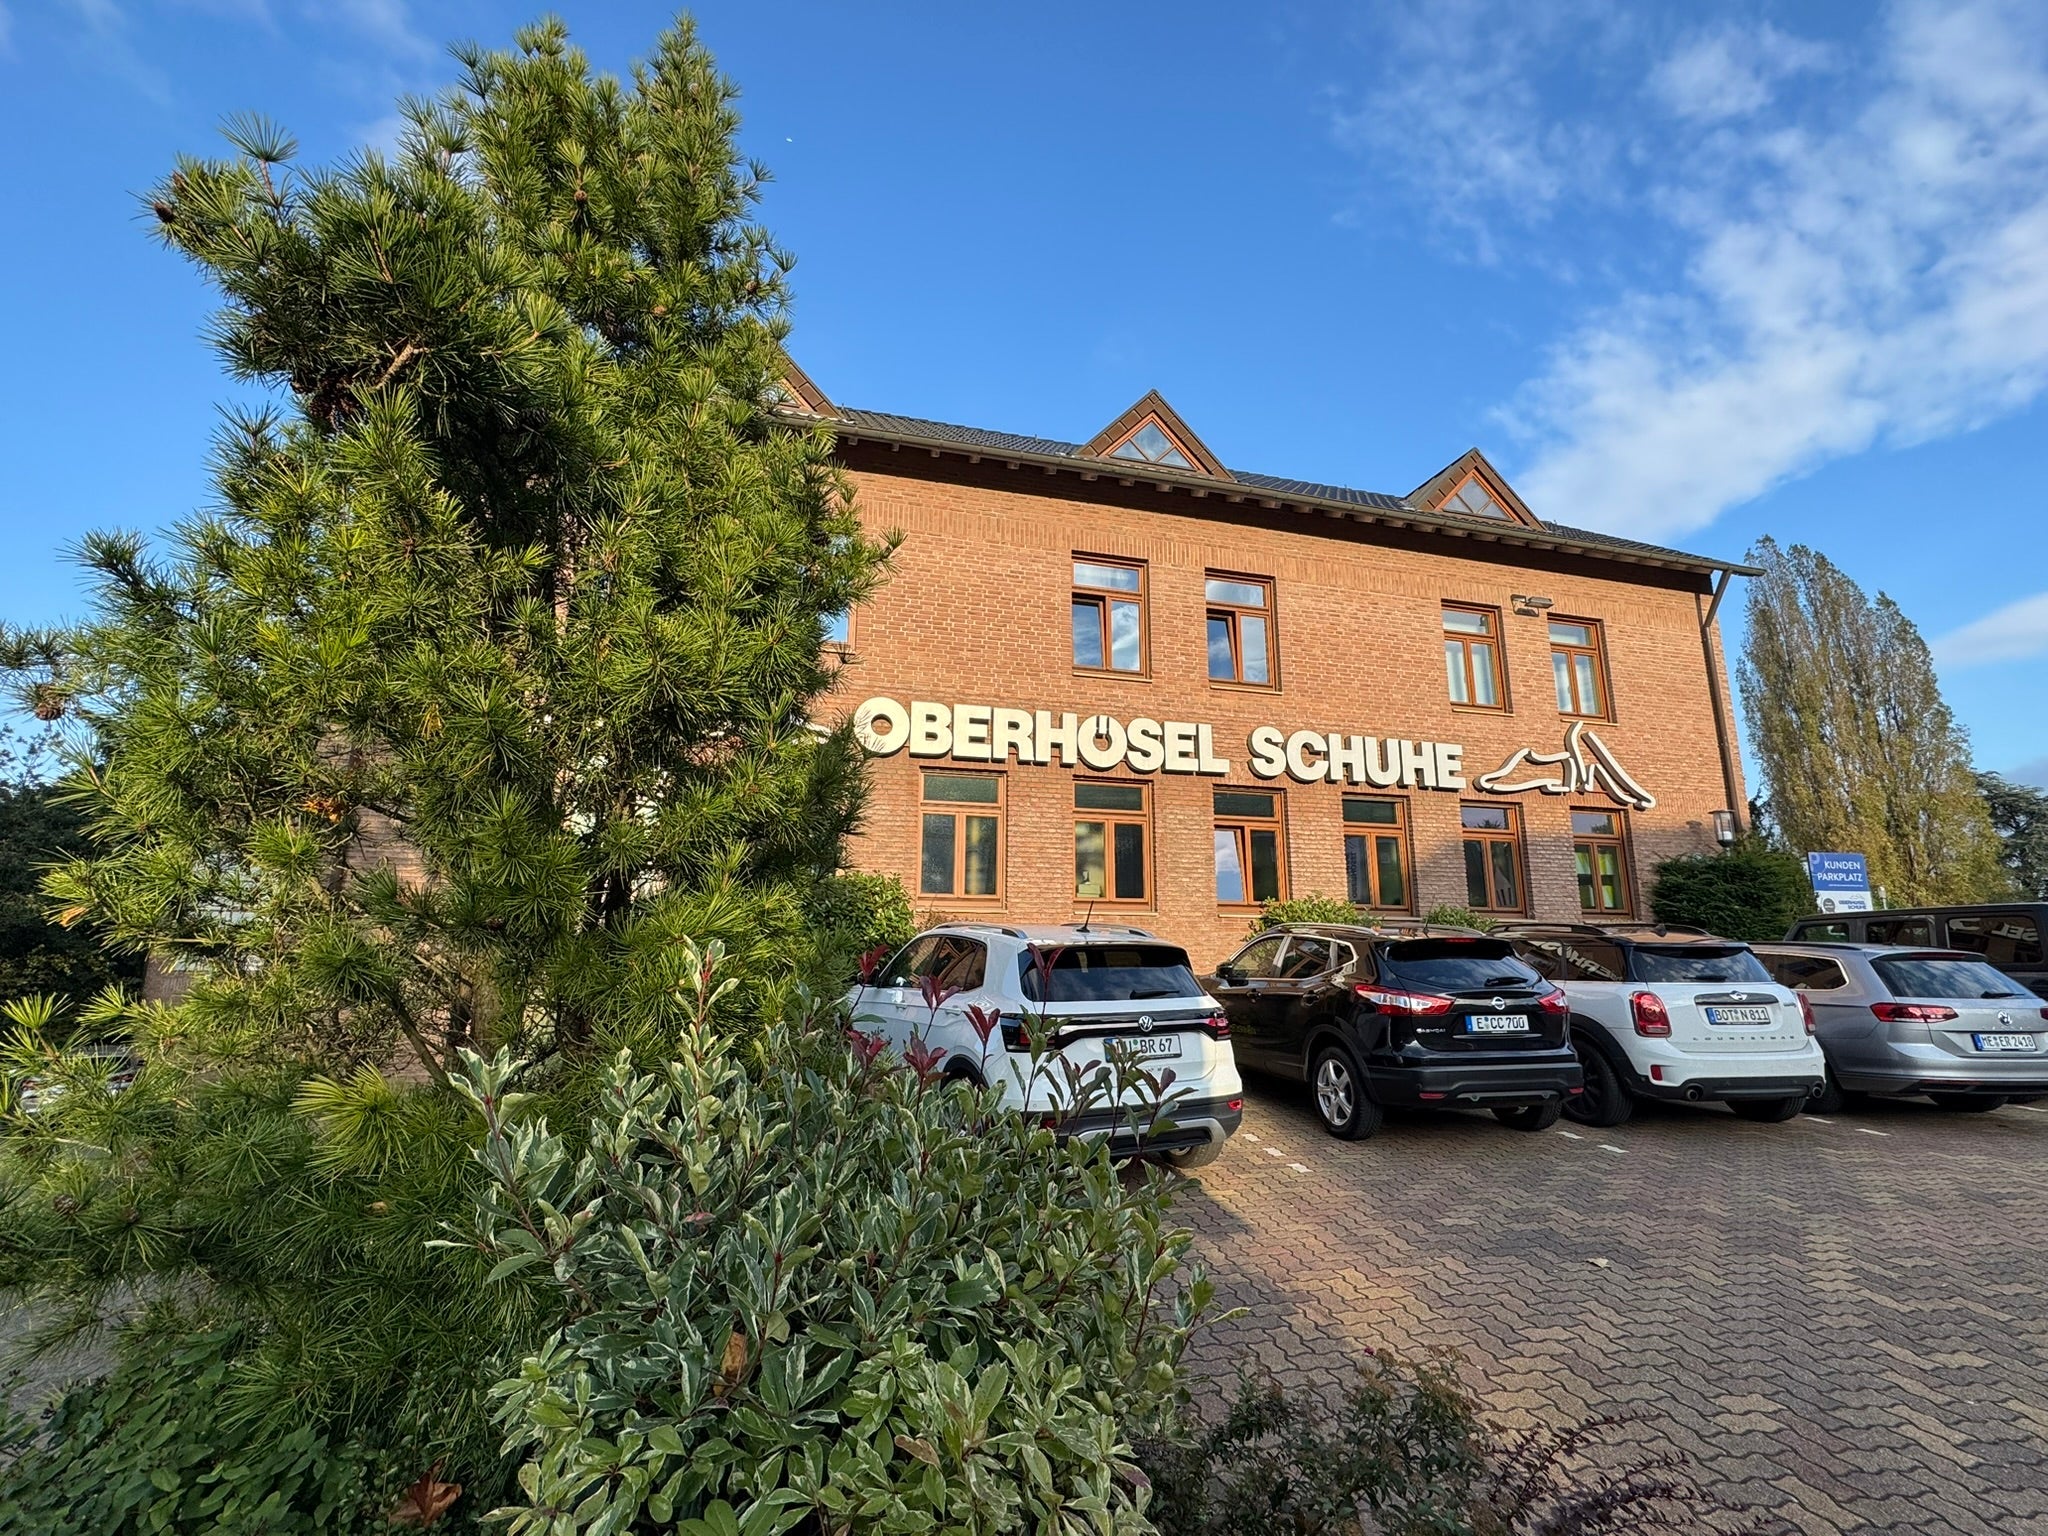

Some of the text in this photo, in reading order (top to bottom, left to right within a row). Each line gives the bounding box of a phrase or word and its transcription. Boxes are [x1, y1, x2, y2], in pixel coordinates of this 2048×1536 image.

[854, 696, 1467, 792] OBERHÖSEL SCHUHE
[1824, 861, 1861, 870] KUNDEN
[1817, 872, 1863, 882] PARKPLATZ
[1714, 1009, 1769, 1021] BOT N 811
[1476, 1017, 1525, 1030] E CC 700
[1140, 1039, 1156, 1053] BR
[1159, 1038, 1172, 1052] 67
